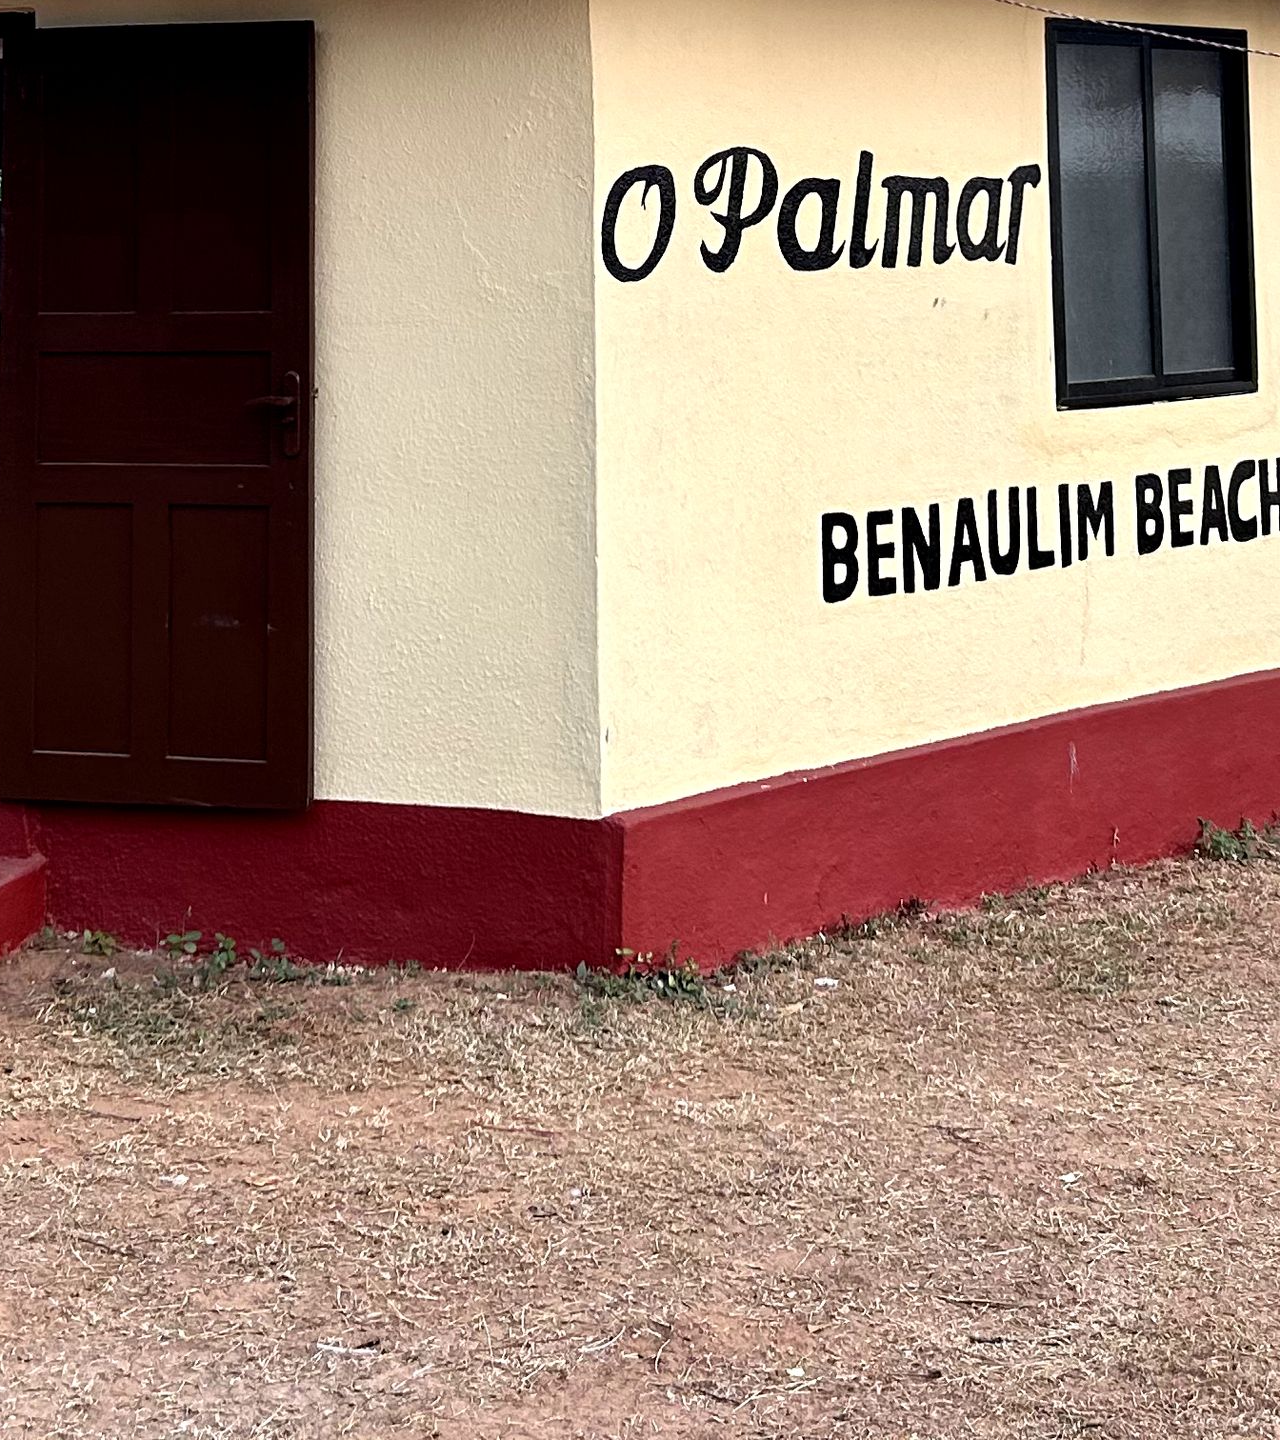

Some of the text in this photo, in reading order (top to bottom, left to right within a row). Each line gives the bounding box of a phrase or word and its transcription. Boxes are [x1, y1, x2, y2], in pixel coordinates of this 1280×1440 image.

[601, 146, 1042, 283] O Palmar
[820, 480, 1116, 604] BENAULIM
